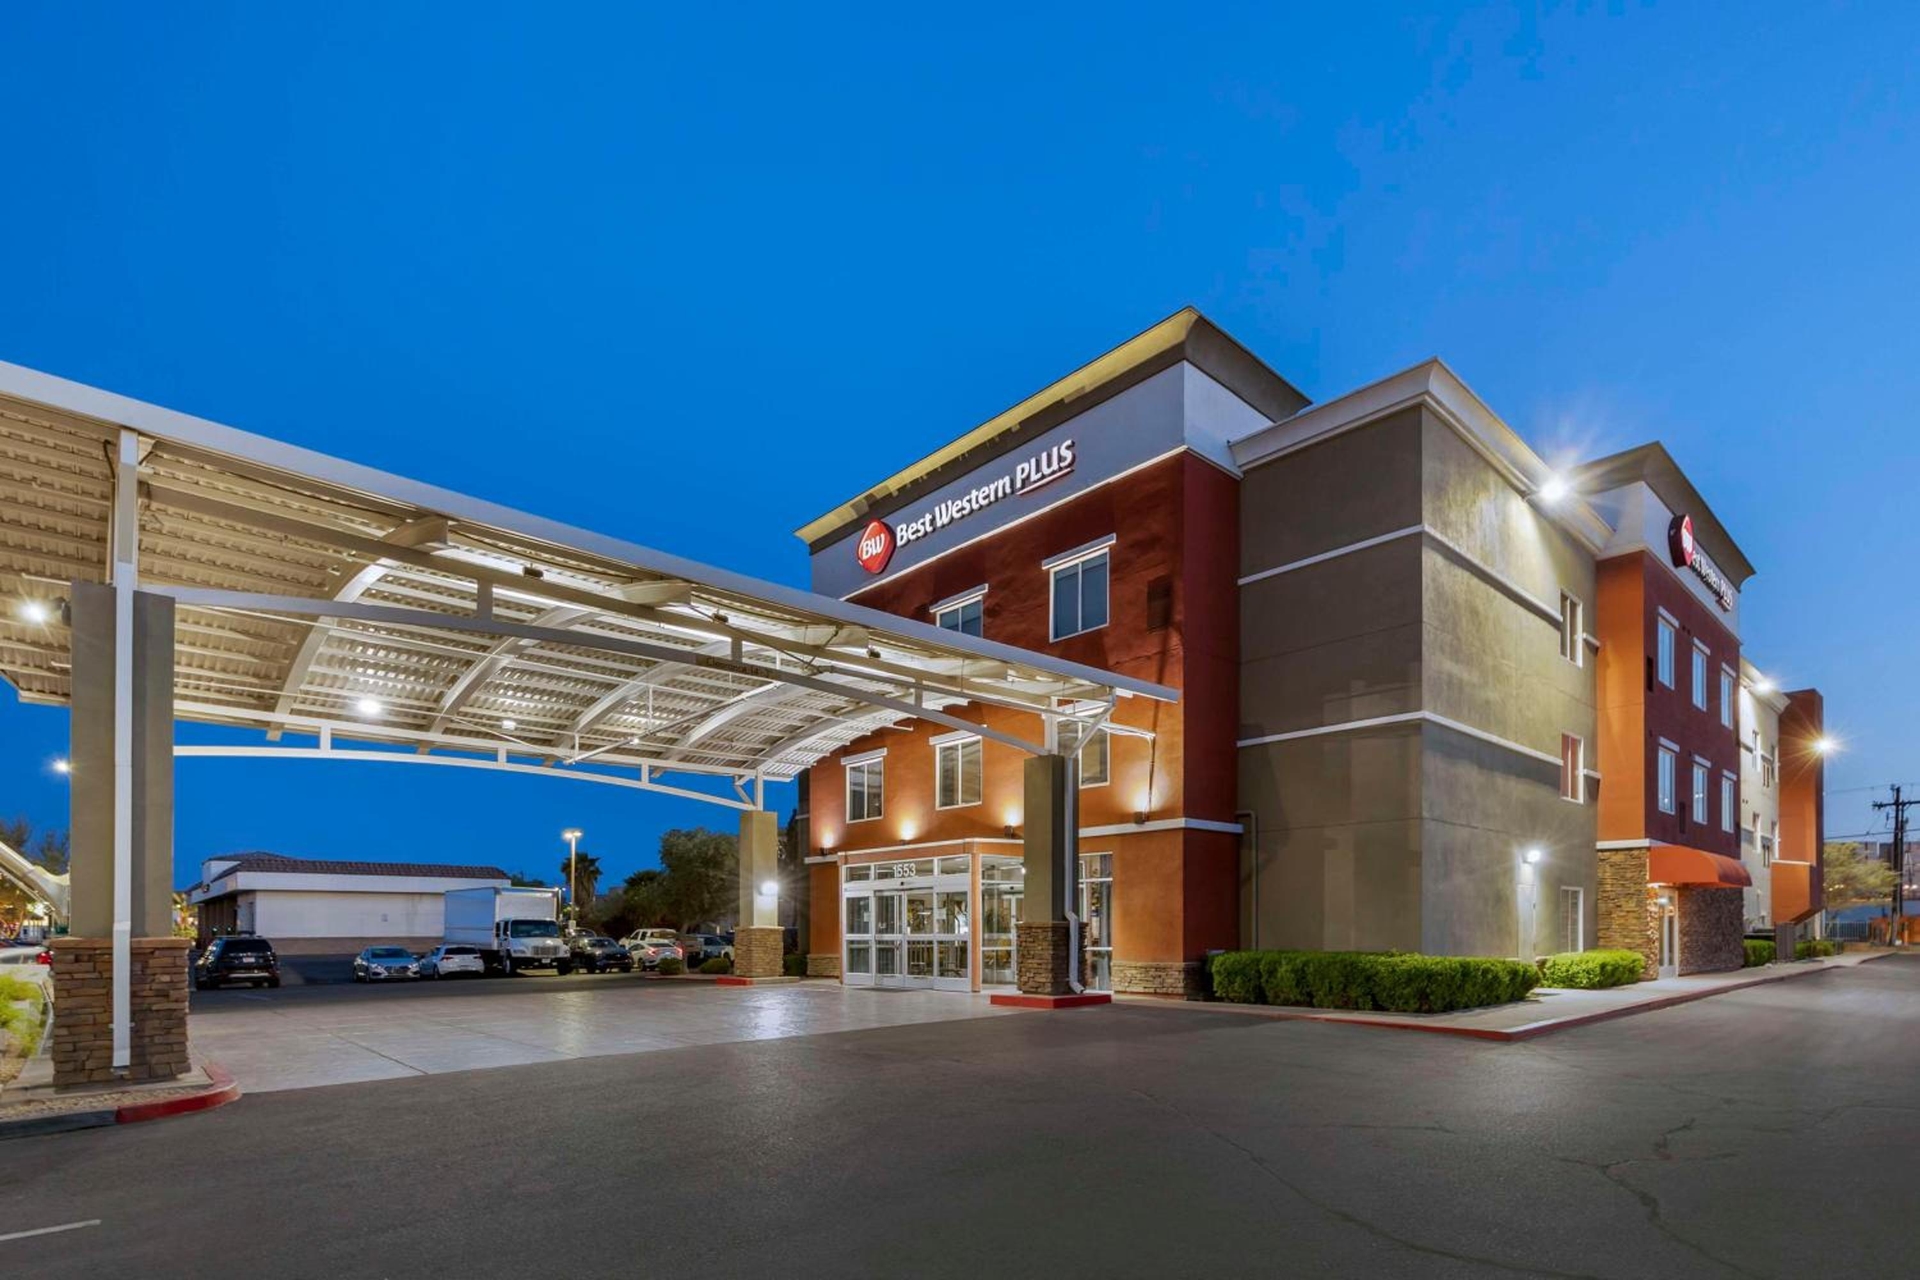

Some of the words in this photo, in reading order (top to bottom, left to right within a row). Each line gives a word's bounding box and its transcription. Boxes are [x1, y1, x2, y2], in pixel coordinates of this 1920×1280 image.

[896, 512, 934, 547] Best
[934, 475, 1012, 528] Western
[1015, 439, 1074, 489] PLUS
[862, 533, 885, 560] BW
[892, 863, 916, 879] 1553
